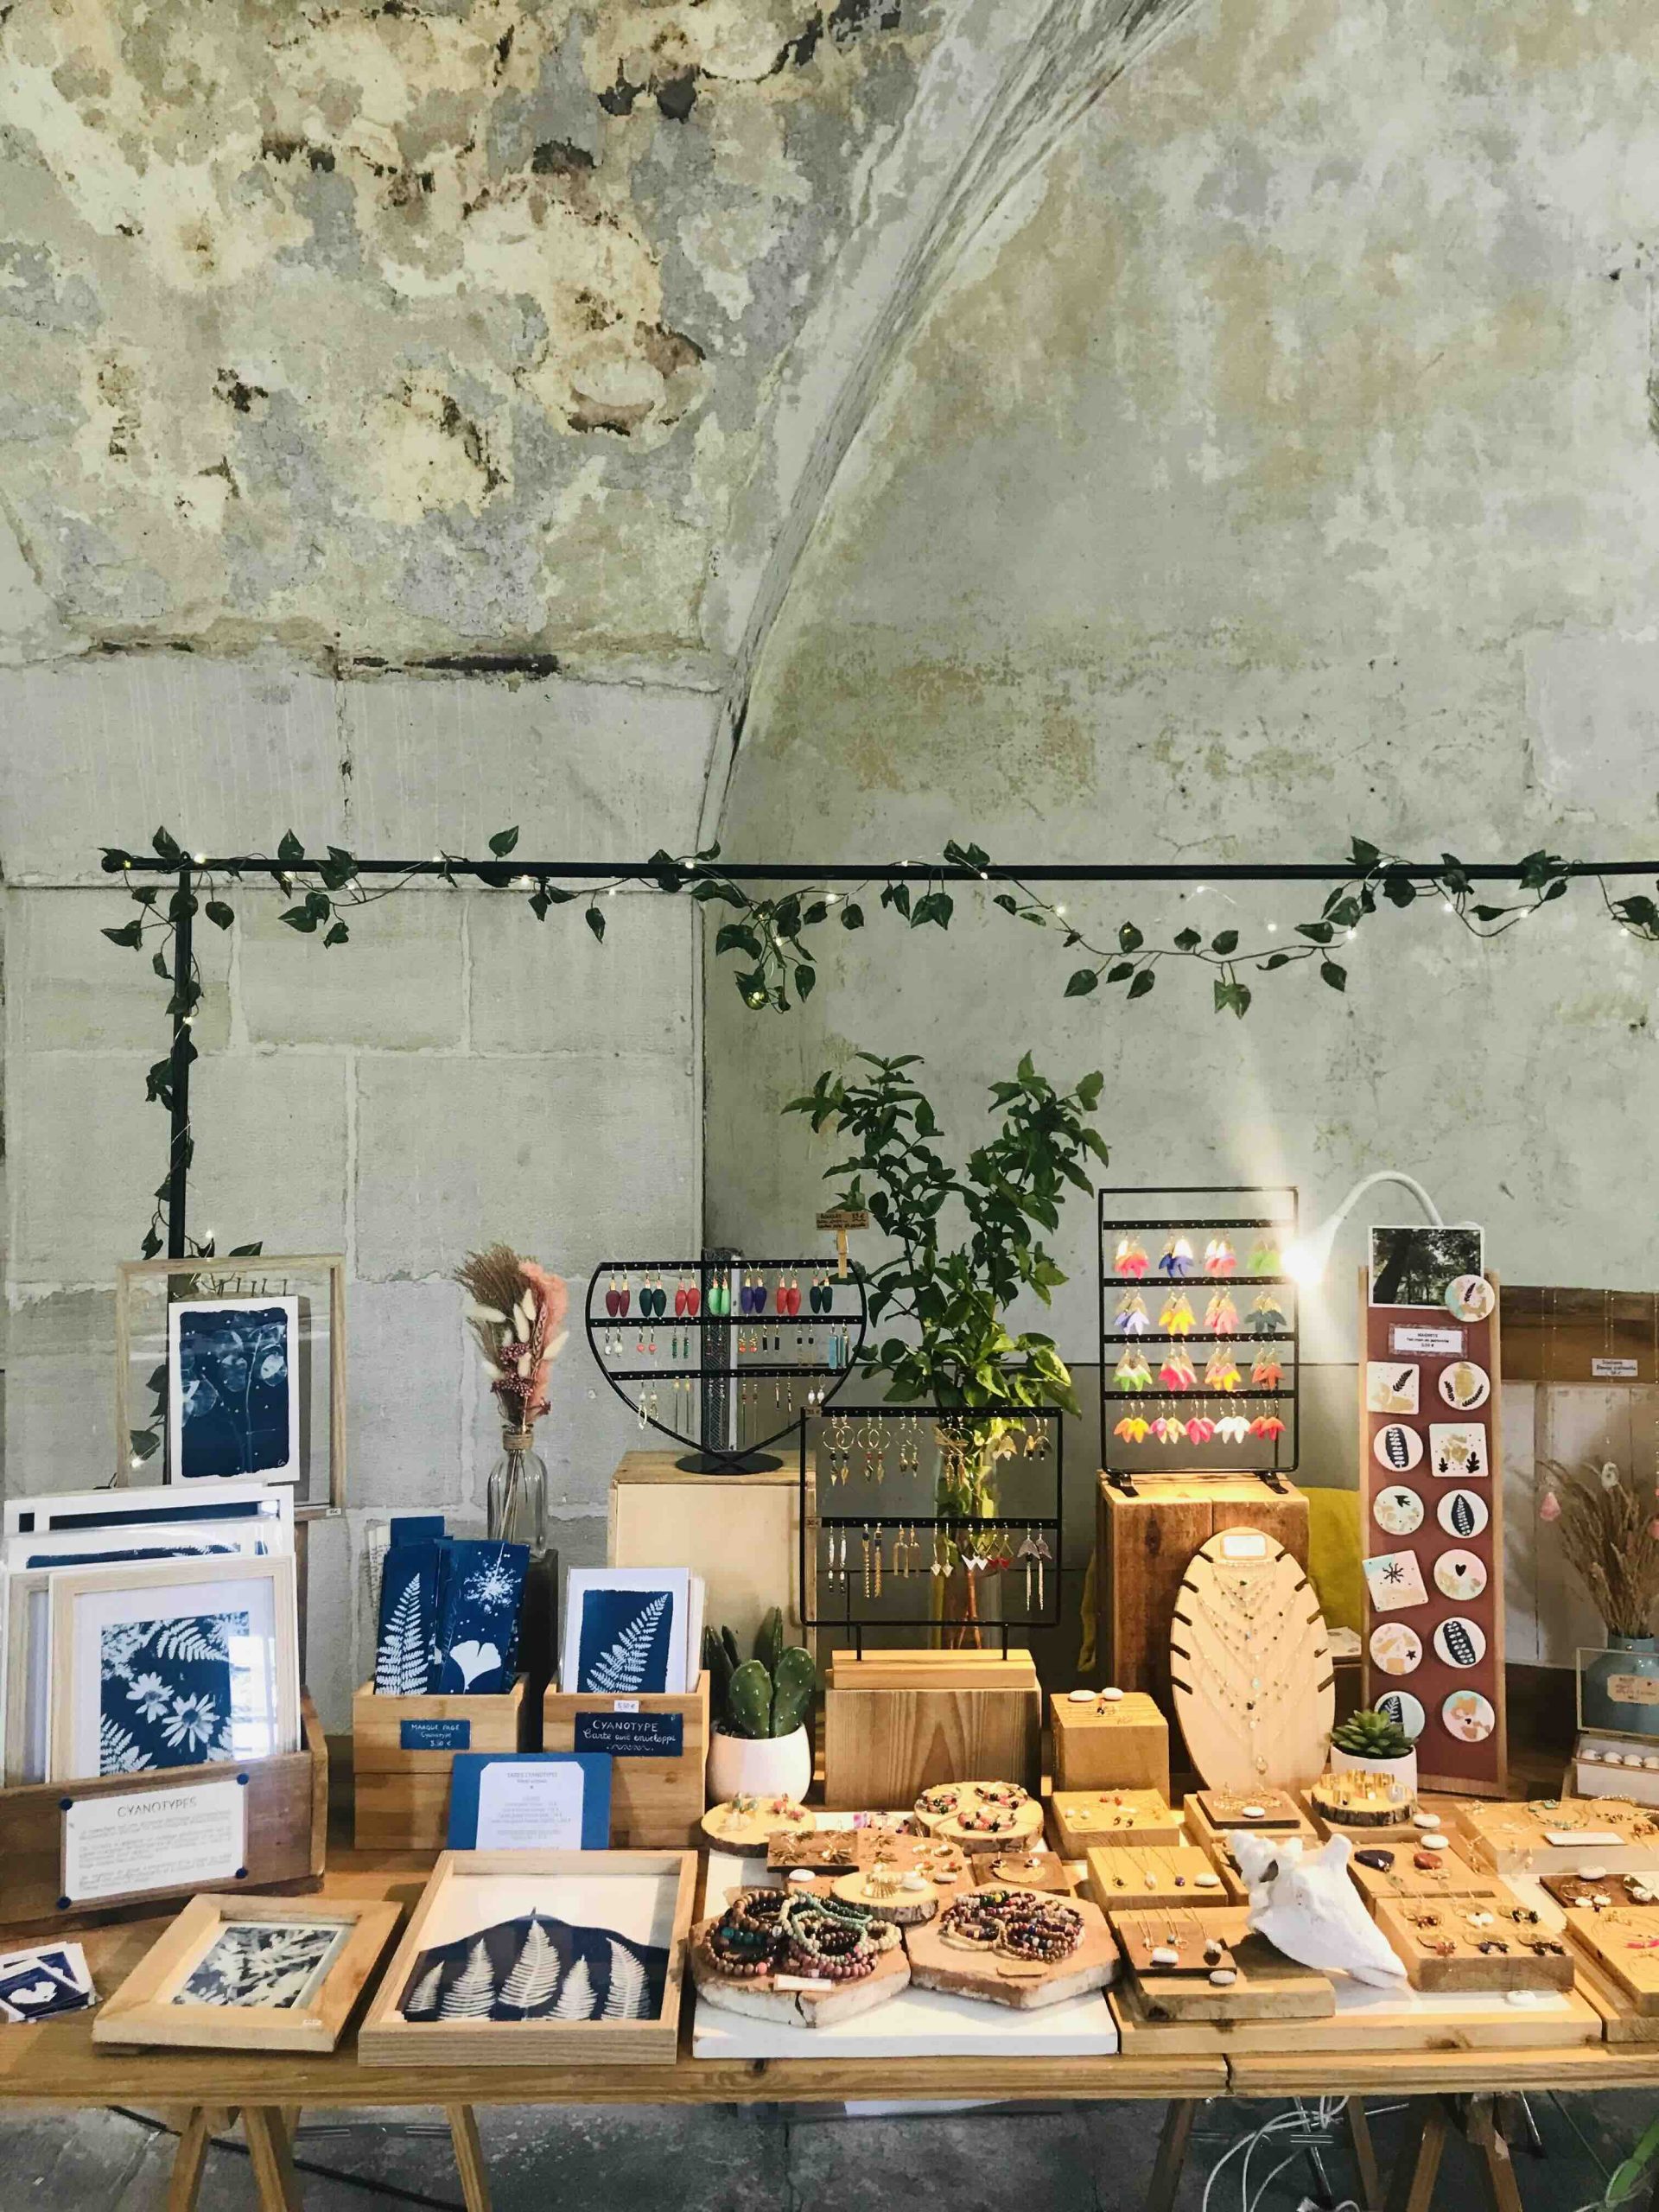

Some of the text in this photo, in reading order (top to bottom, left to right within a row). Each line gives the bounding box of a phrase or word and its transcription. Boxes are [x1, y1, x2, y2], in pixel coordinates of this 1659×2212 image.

[593, 1719, 658, 1732] CYANOTYPE
[582, 1729, 612, 1740] Carte
[633, 1733, 676, 1745] enveloppe
[118, 1797, 197, 1818] CYANOTYPES
